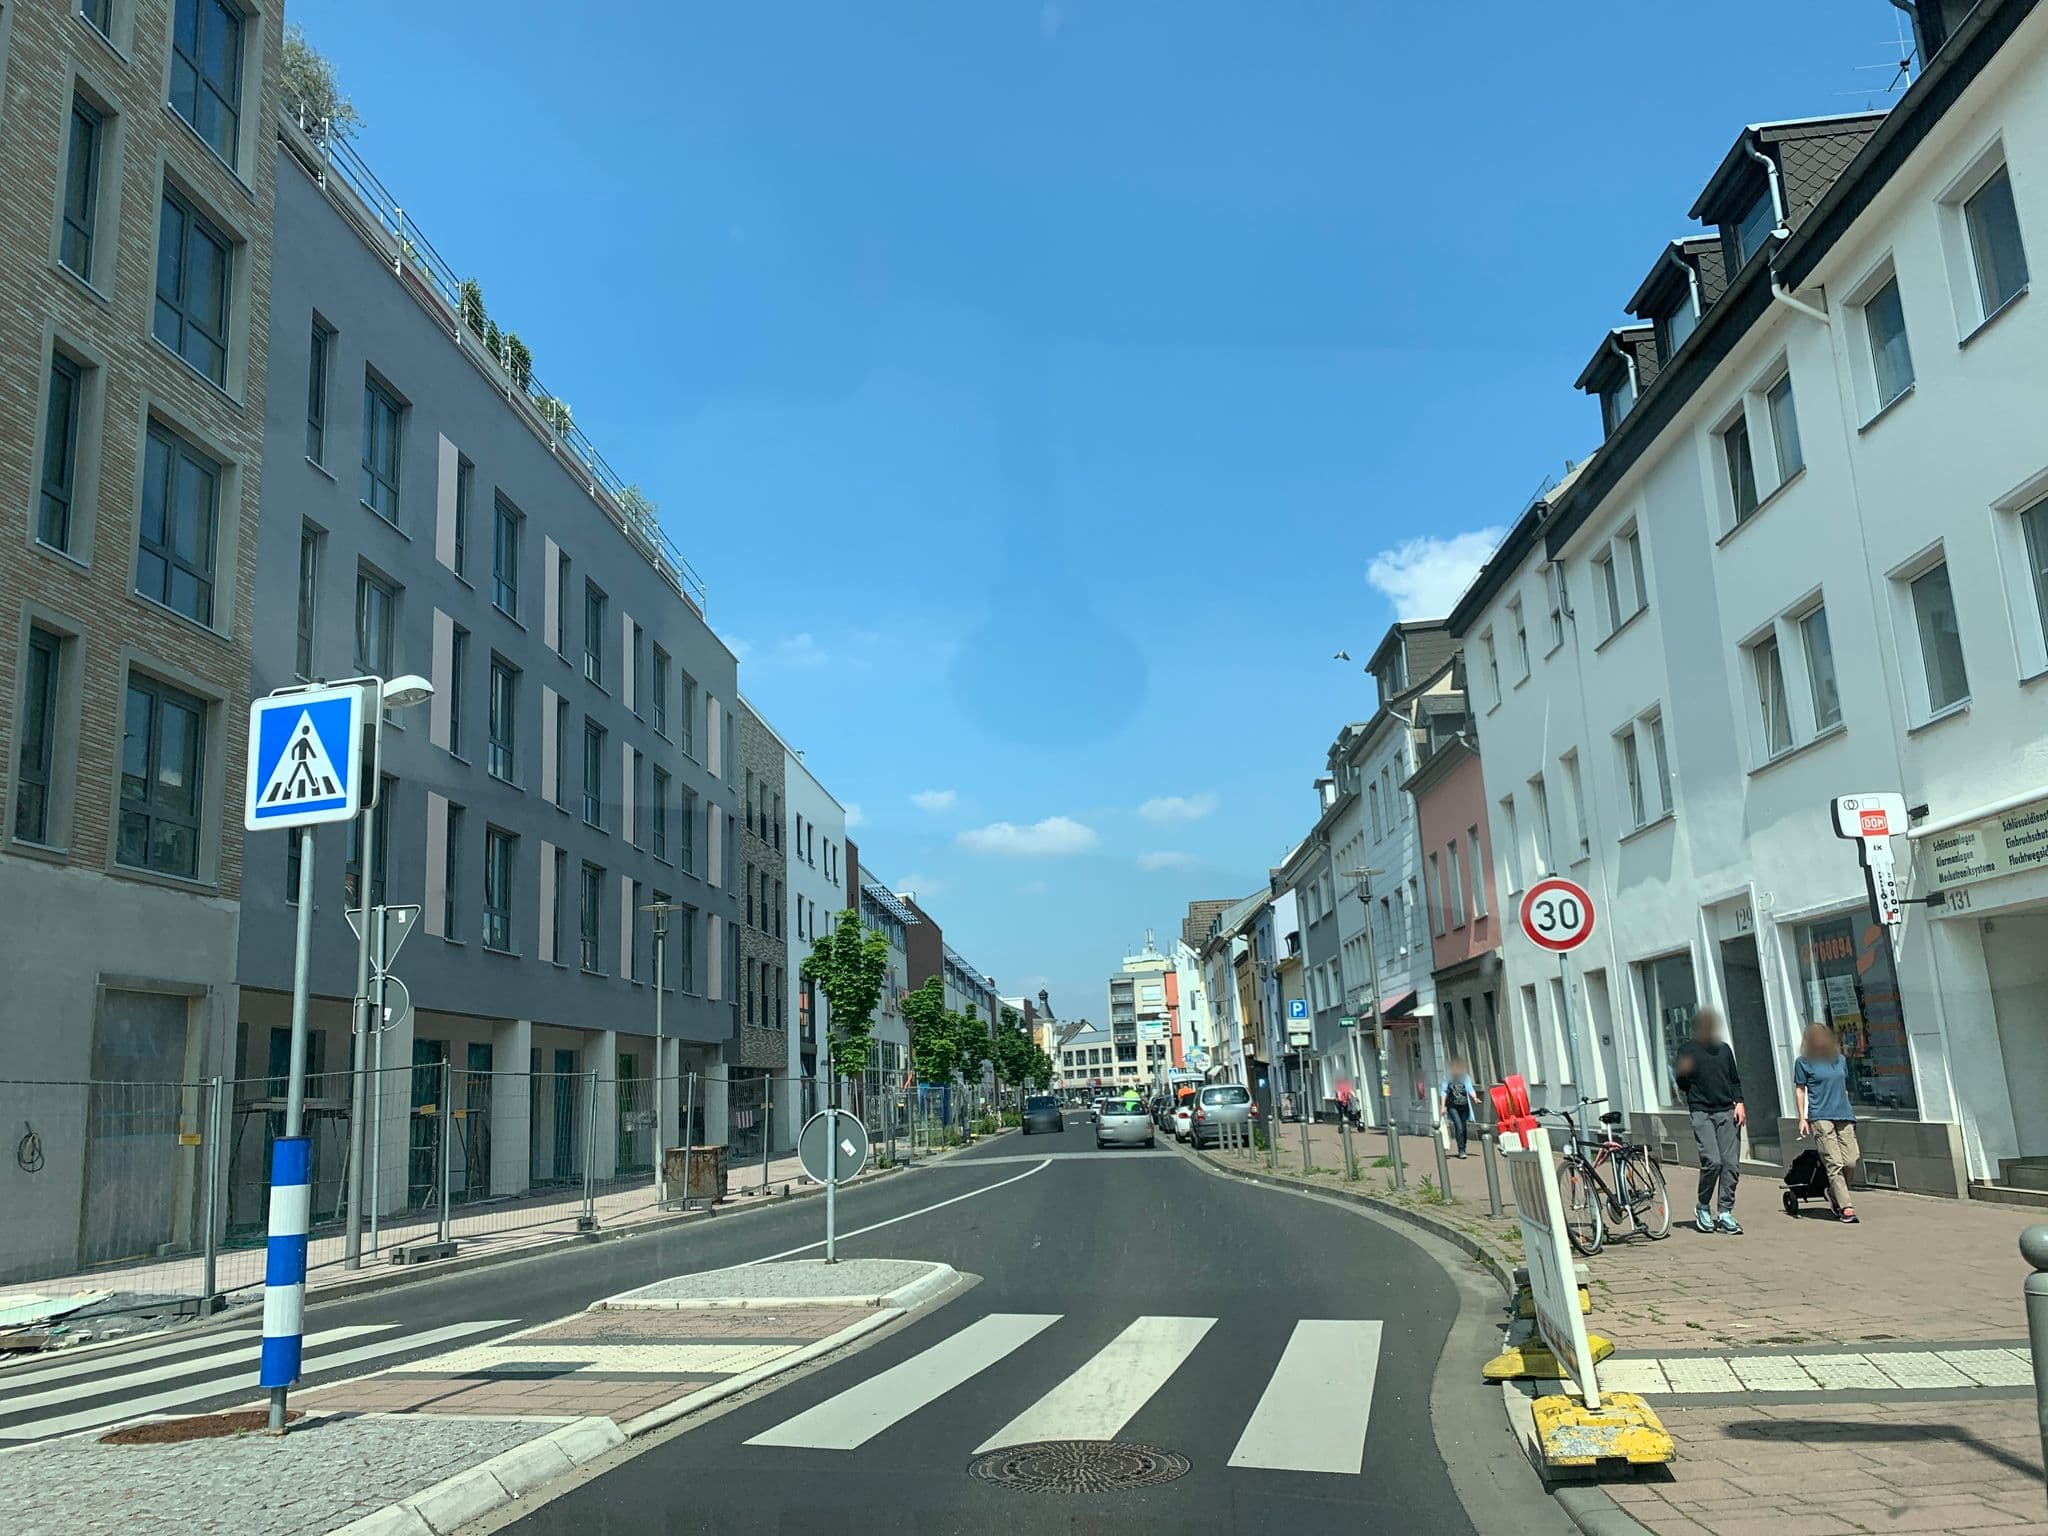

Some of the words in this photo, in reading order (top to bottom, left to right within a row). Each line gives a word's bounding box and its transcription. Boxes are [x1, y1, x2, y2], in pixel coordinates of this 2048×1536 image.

[1864, 818, 1885, 828] DOM
[1933, 834, 1975, 852] Schliessanlagen
[1936, 851, 1974, 867] Alarmanlagen
[1938, 863, 1995, 883] Mechatroniksysteme
[1949, 889, 1971, 911] 131
[1536, 898, 1579, 931] 30
[1735, 906, 1754, 932] 129
[1292, 1002, 1303, 1017] P
